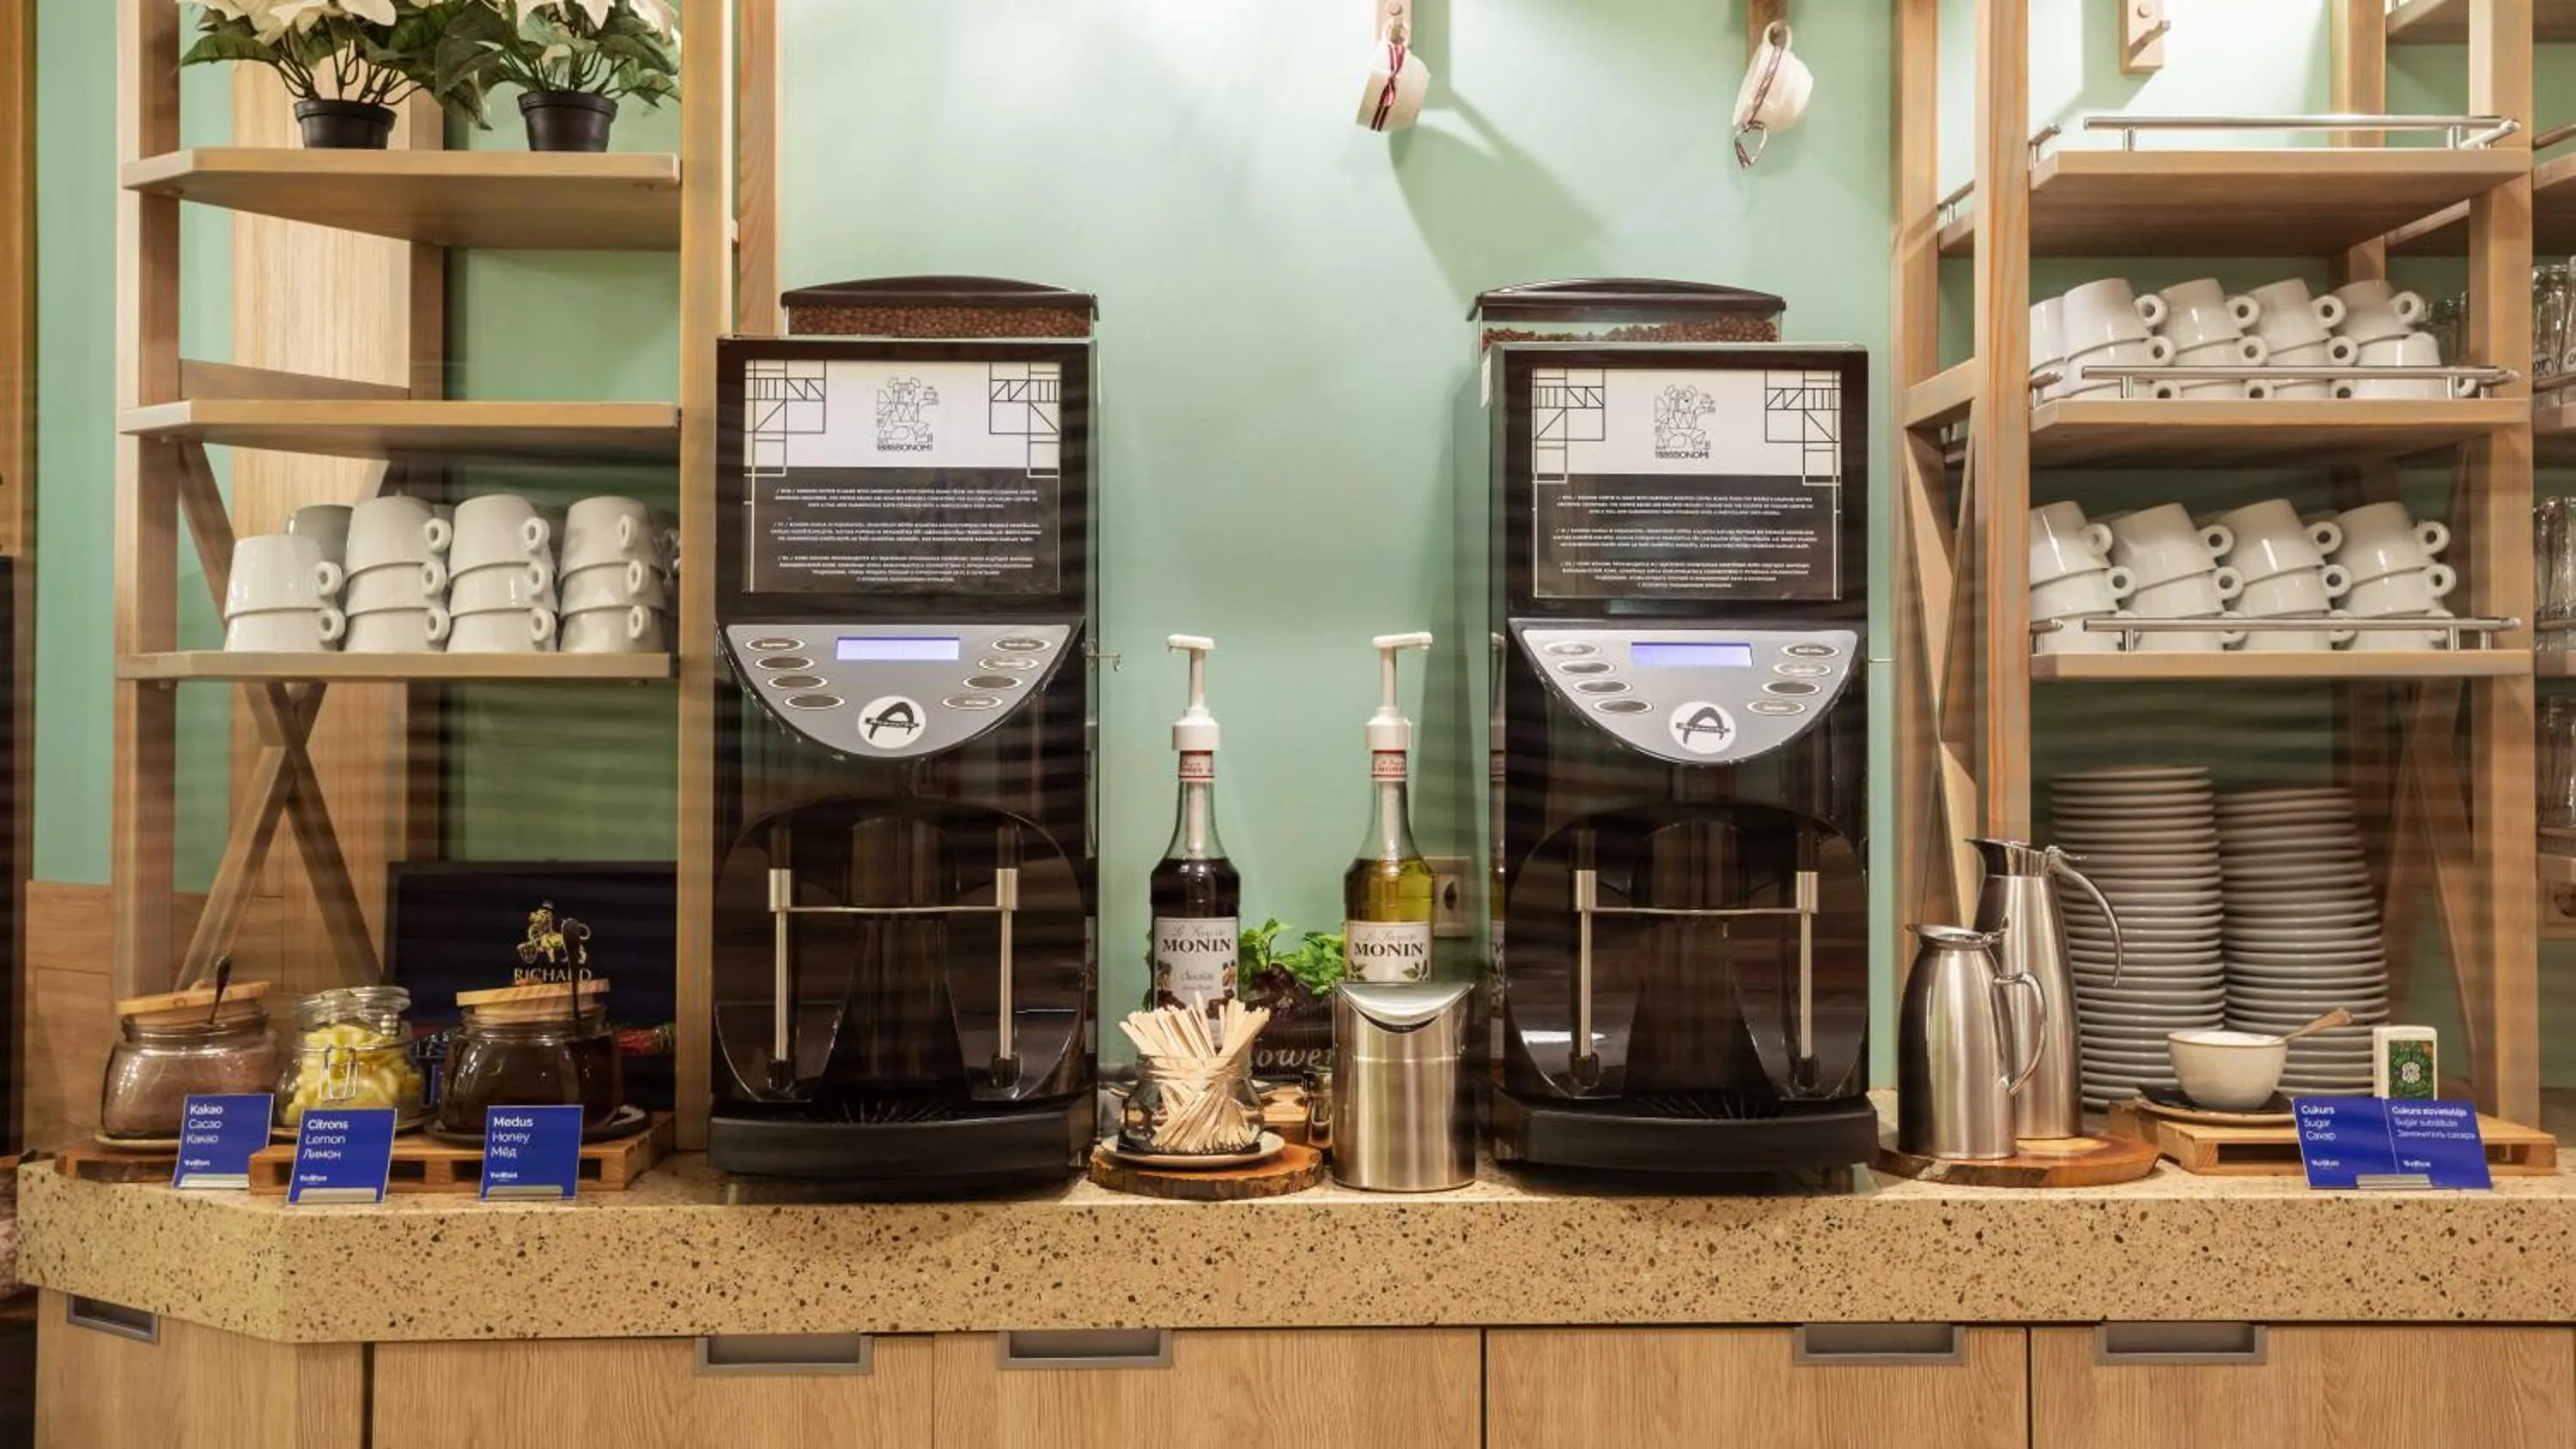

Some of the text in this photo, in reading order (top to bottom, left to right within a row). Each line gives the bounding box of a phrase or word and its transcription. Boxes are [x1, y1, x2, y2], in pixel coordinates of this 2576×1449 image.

[1162, 938, 1231, 953] MONIN
[1354, 942, 1423, 957] MONIN
[190, 1104, 223, 1115] Kakao
[188, 1119, 222, 1129] Cacao
[307, 1119, 349, 1131] Citrons
[494, 1115, 534, 1127] Medus
[305, 1134, 346, 1144] Lemon
[492, 1131, 531, 1147] Honey
[302, 1148, 342, 1160] Лимон
